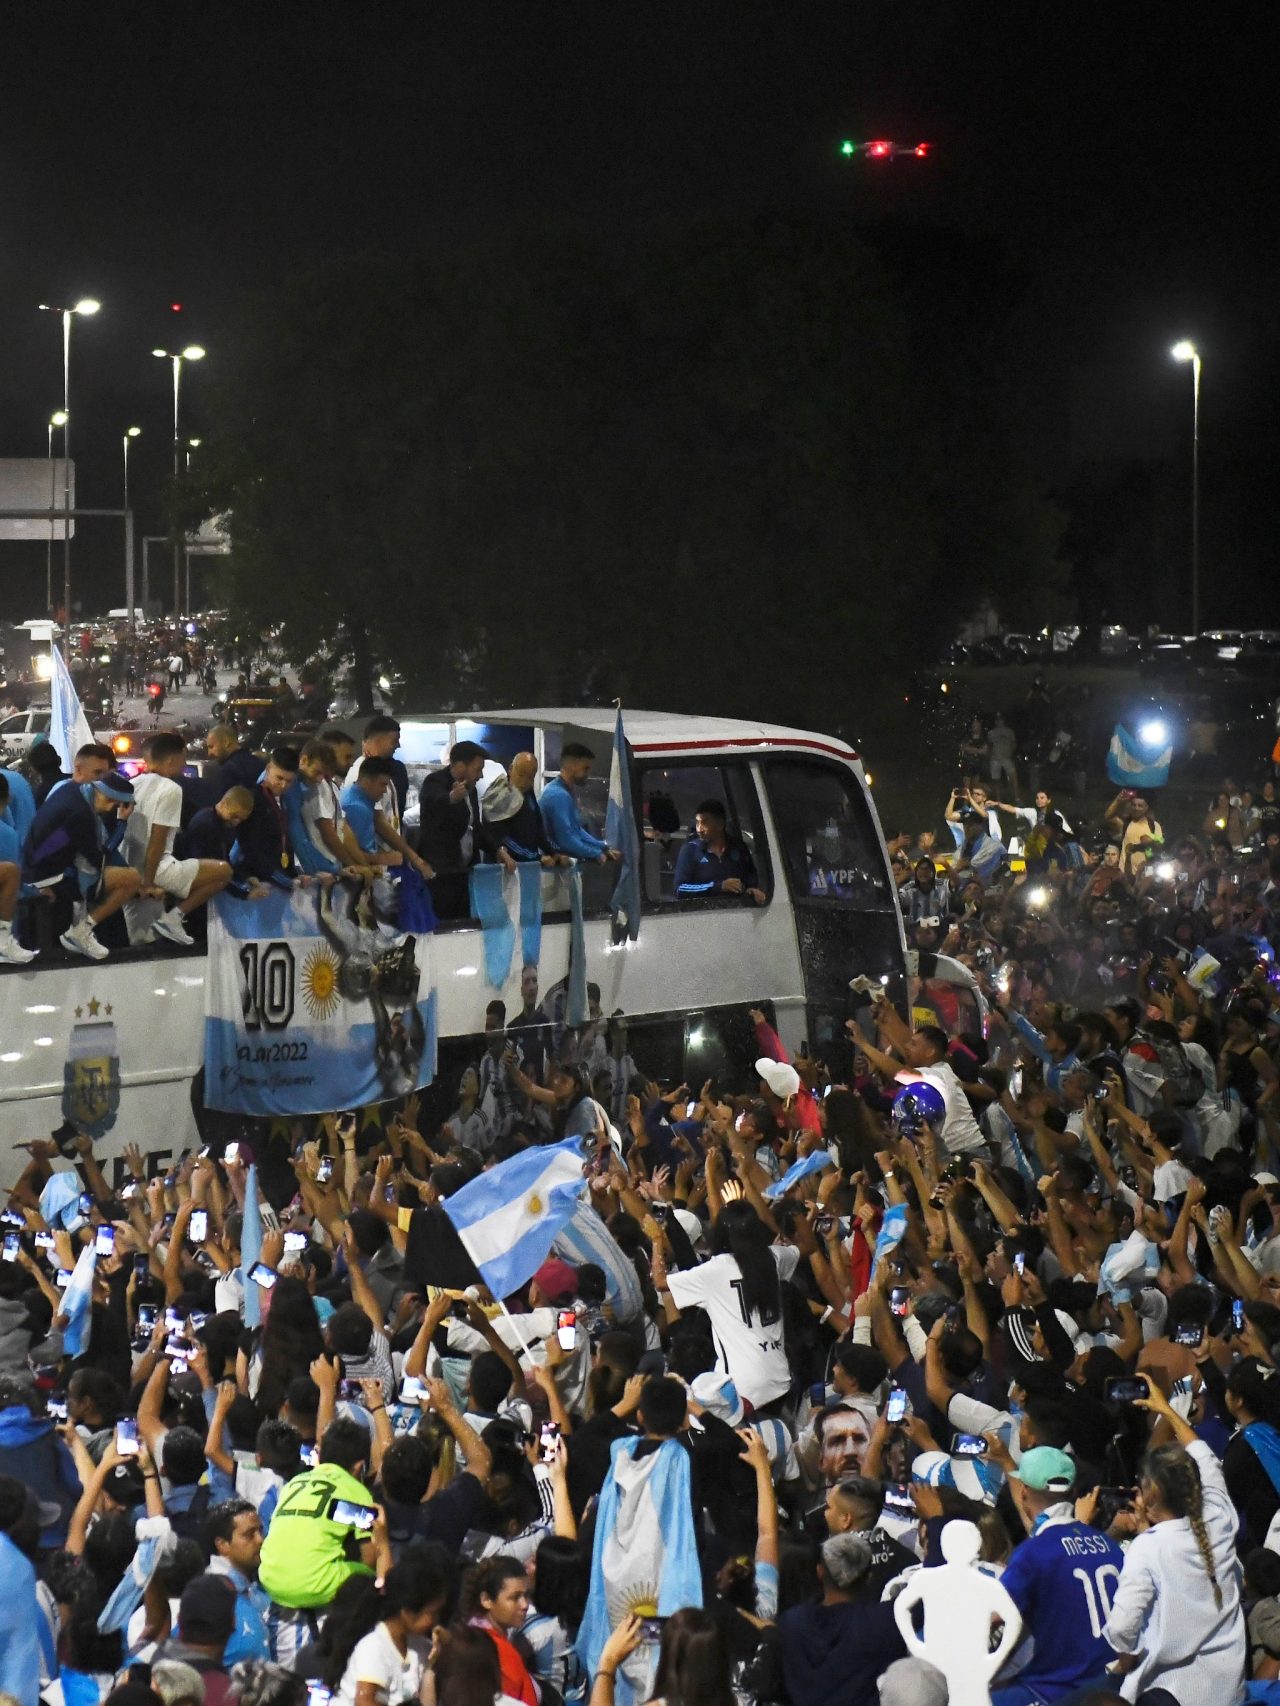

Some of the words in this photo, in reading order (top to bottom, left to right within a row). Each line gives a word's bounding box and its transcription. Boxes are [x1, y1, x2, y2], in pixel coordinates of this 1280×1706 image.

[830, 869, 856, 884] YPF
[239, 942, 296, 1031] 10
[275, 1479, 337, 1519] 23
[1060, 1534, 1111, 1557] MESSI
[1072, 1563, 1120, 1639] 10
